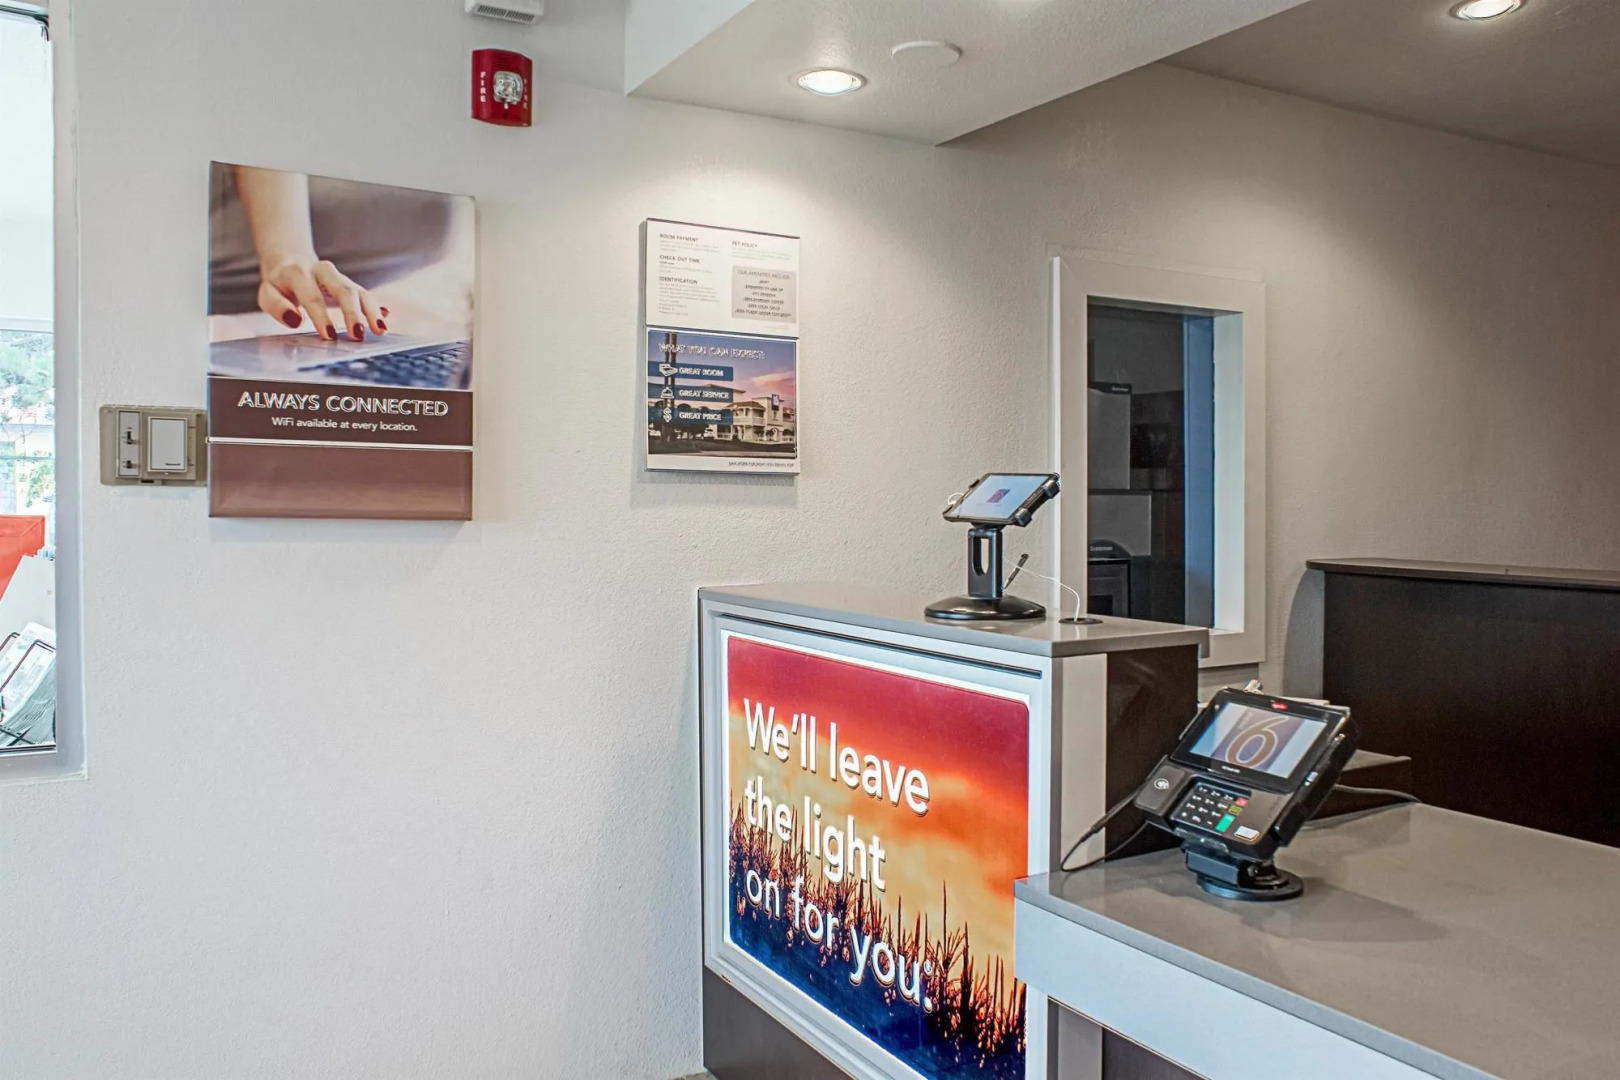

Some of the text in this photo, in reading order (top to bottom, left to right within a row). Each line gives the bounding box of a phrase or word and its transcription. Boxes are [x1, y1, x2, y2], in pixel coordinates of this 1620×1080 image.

[659, 276, 698, 284] IDENTIFICATION
[687, 345, 707, 355] YOU
[709, 346, 728, 356] CAN
[679, 367, 724, 376] GREAT ROOM
[678, 389, 729, 399] GREAT SERVICE
[237, 391, 449, 416] ALWAYS CONNECTED
[679, 411, 722, 421] GREAT PRICE
[272, 416, 418, 432] WiFi available at every location.
[743, 697, 930, 816] We'll leave
[744, 774, 886, 892] the light
[745, 868, 780, 920] on
[790, 872, 839, 951] for
